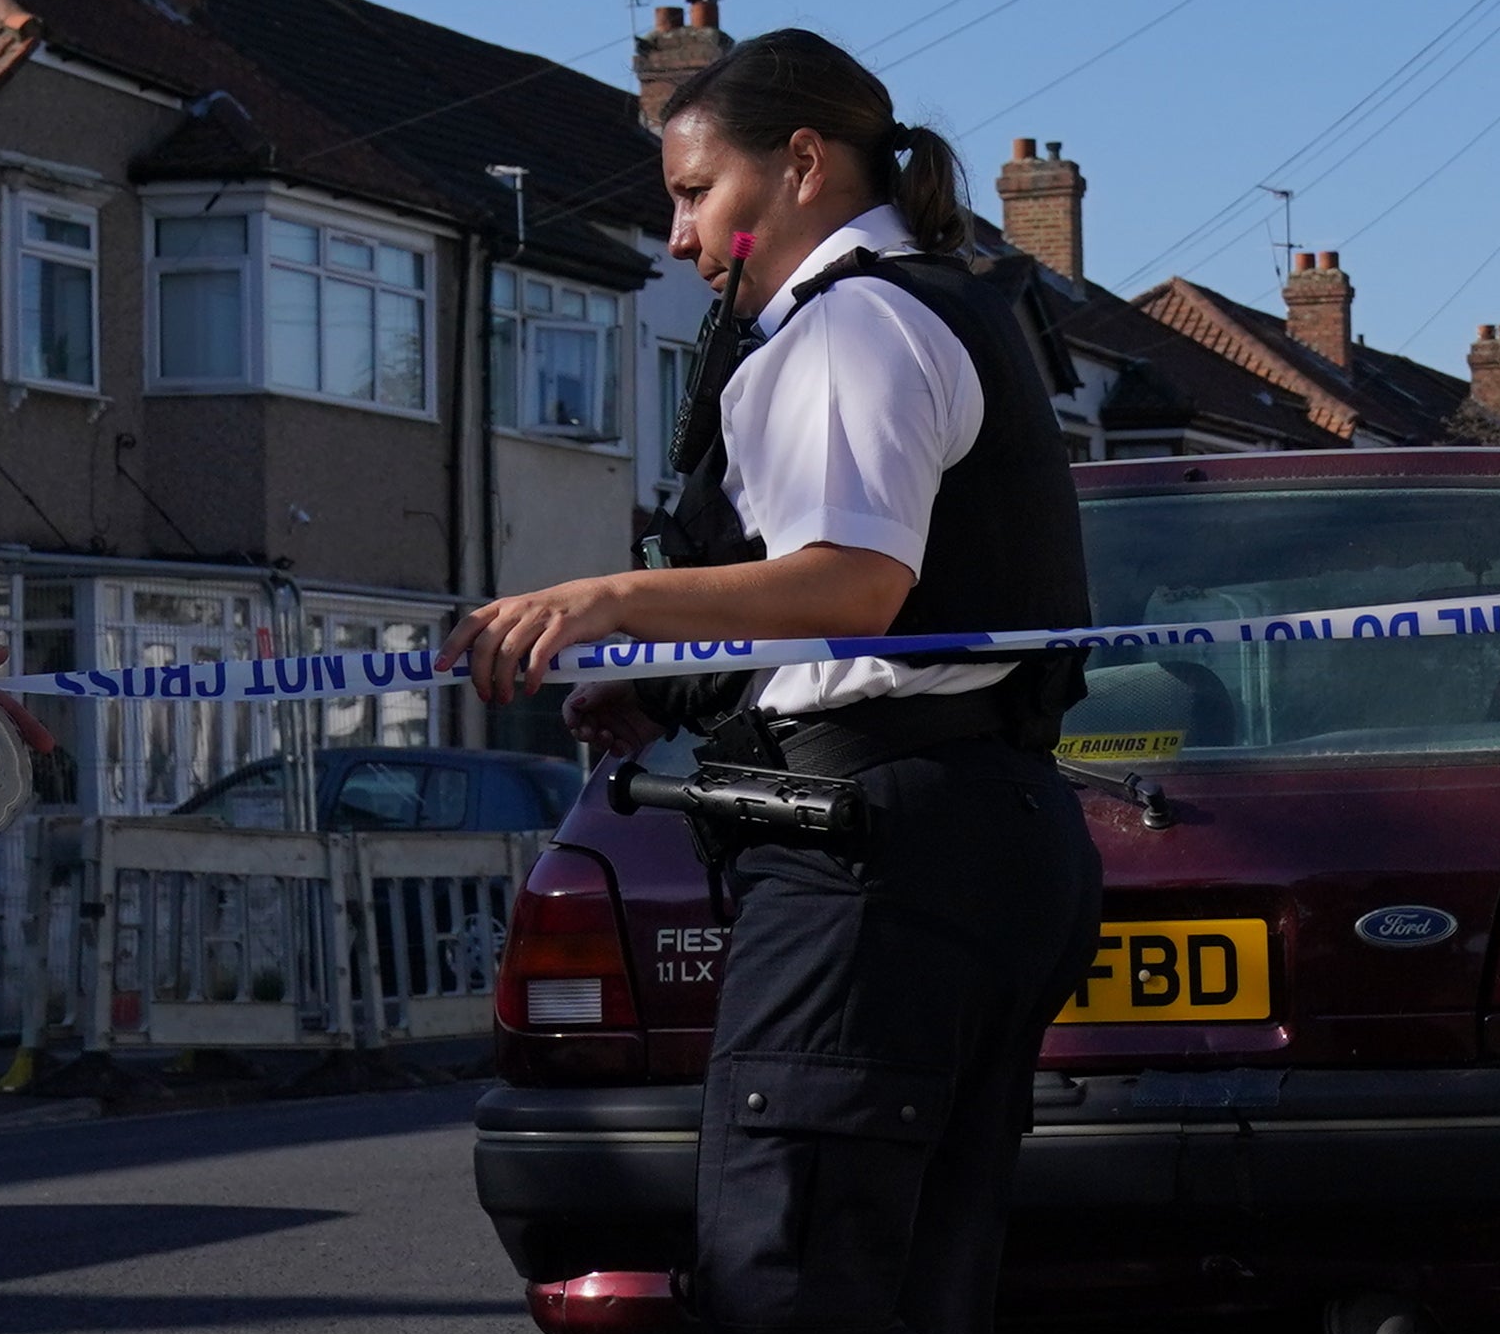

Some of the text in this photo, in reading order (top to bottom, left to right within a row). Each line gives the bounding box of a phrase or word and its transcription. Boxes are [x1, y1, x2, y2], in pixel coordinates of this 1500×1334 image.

[55, 660, 227, 698] CROSS
[243, 655, 347, 697] NOT
[1080, 737, 1148, 754] RAUNDS
[1379, 913, 1432, 936] Ford
[657, 928, 731, 953] FIES
[681, 960, 714, 982] LX
